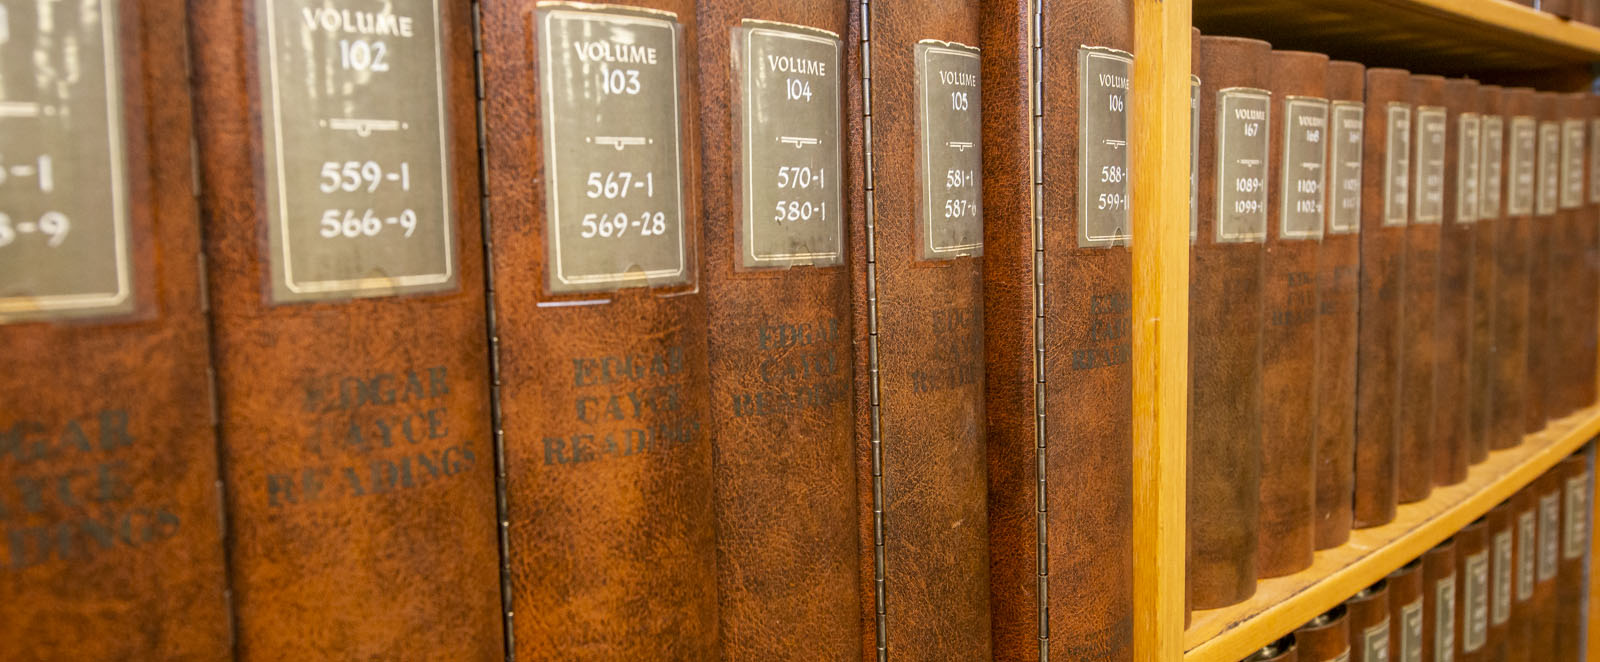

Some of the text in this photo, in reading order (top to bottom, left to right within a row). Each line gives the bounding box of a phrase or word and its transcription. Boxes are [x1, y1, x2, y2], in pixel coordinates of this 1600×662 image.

[302, 6, 413, 38] VOLUME
[339, 39, 391, 73] 102
[575, 41, 658, 66] VOLUME
[768, 54, 826, 77] VOLUME
[602, 69, 642, 96] 103
[786, 78, 813, 103] 104
[939, 70, 976, 88] VOLUME
[1099, 73, 1130, 90] VOLUME
[951, 92, 969, 112] 105
[1109, 94, 1124, 113] 106
[1235, 108, 1266, 121] VOLUME
[1244, 122, 1259, 137] 167
[319, 161, 411, 194] 559-1
[586, 171, 654, 199] 567-1
[777, 166, 825, 190] 570-1
[946, 169, 974, 189] 581-1
[774, 200, 826, 223] 580-1
[944, 199, 977, 219] 587-6
[319, 207, 417, 240] 566-9
[581, 211, 666, 239] 569-28
